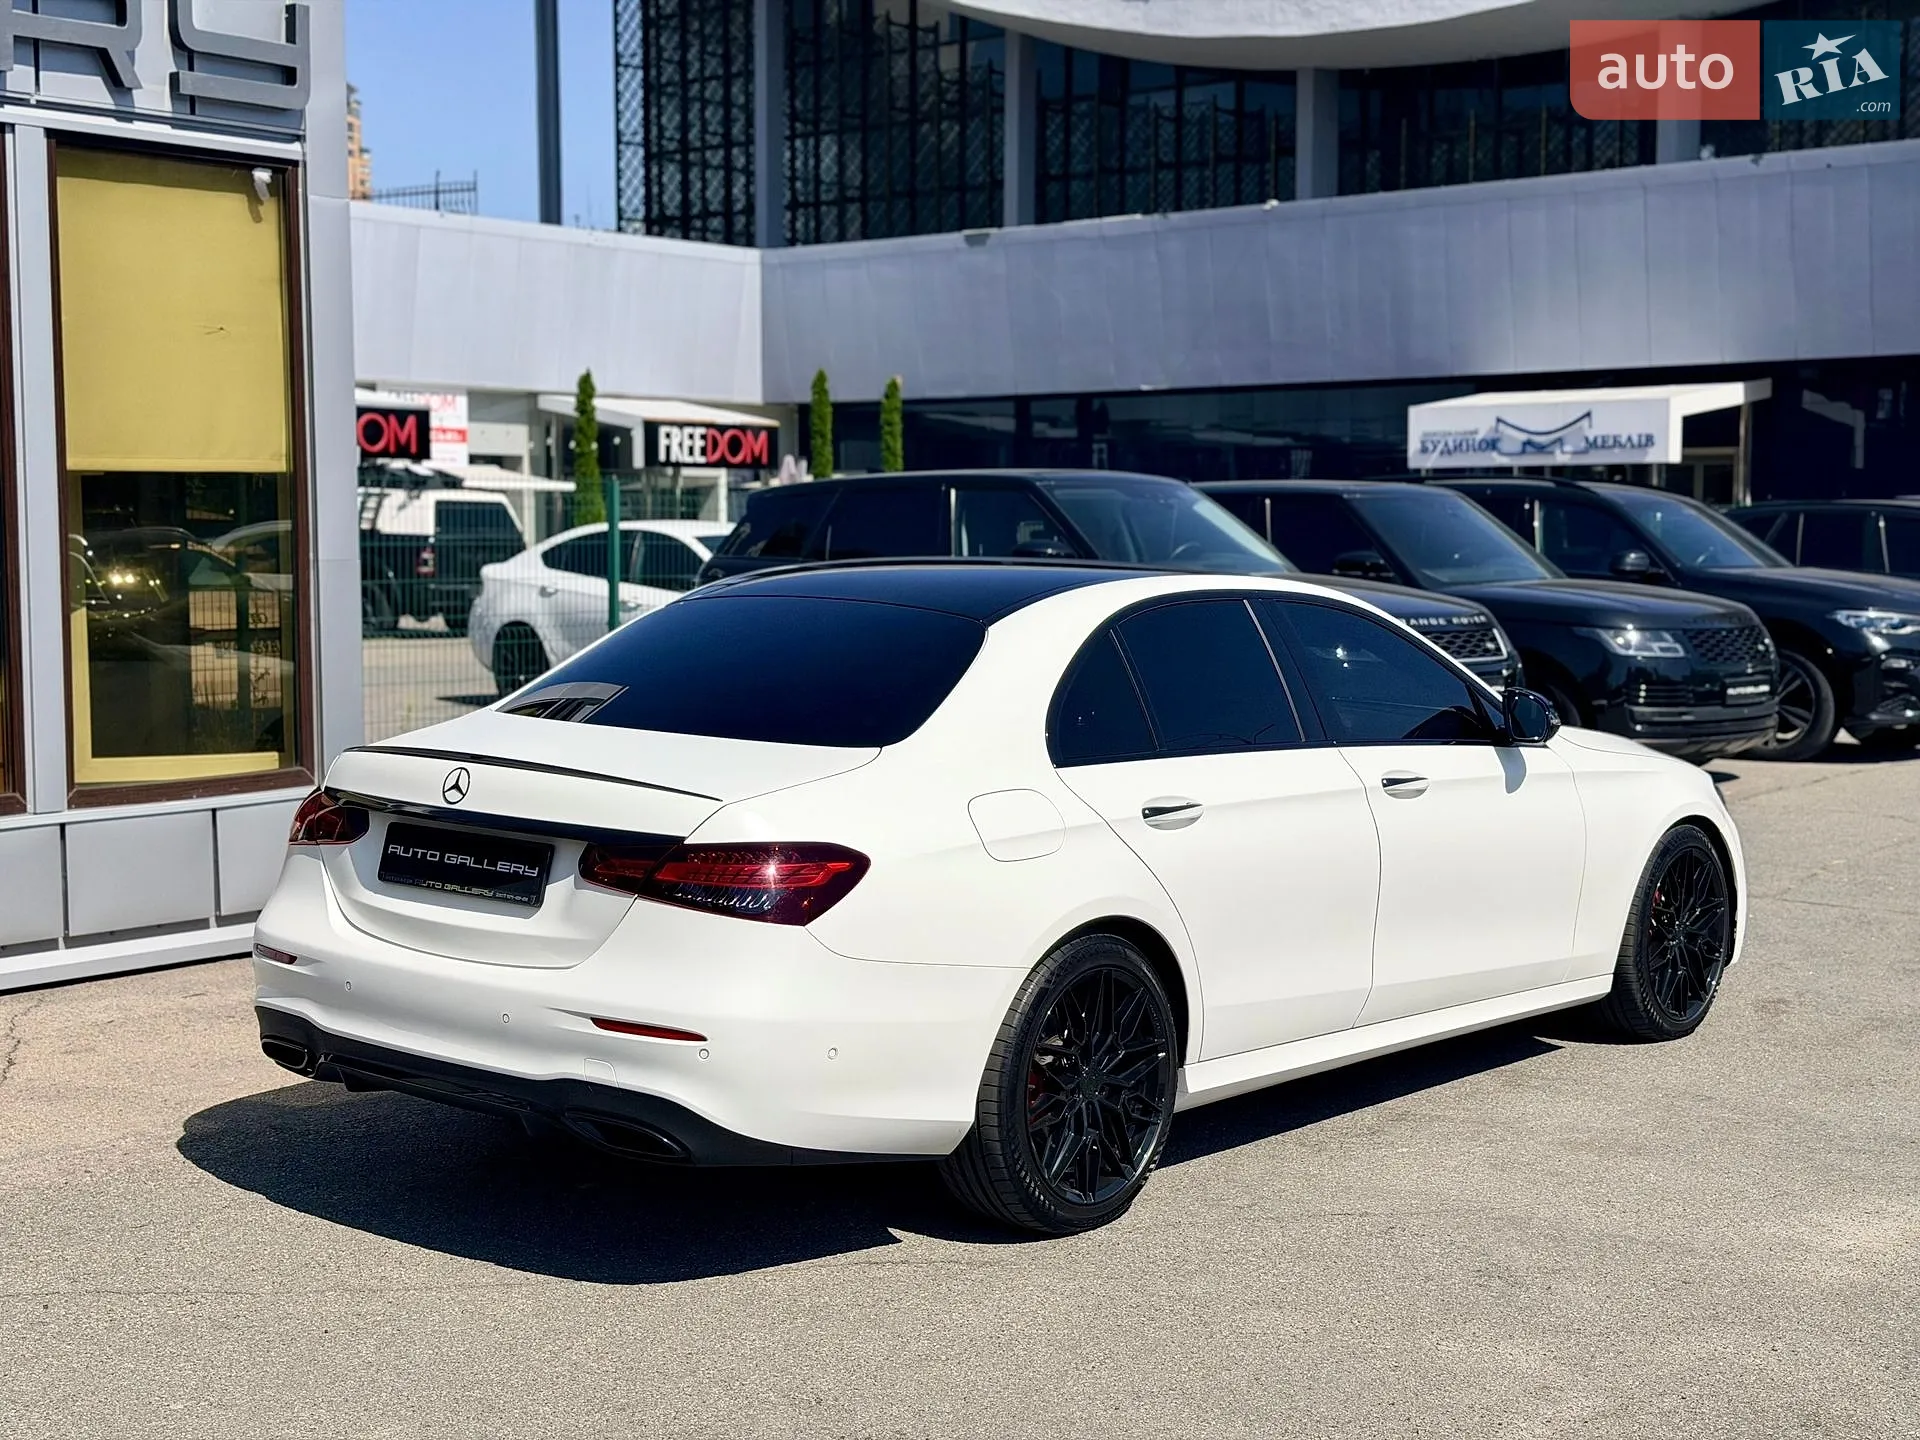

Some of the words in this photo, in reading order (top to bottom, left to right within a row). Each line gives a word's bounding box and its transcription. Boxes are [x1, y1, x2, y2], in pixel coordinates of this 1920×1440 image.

[658, 424, 769, 465] FREEDOM
[387, 844, 440, 862] AUTO
[444, 854, 539, 876] GALLERY
[443, 883, 493, 896] GALLERY
